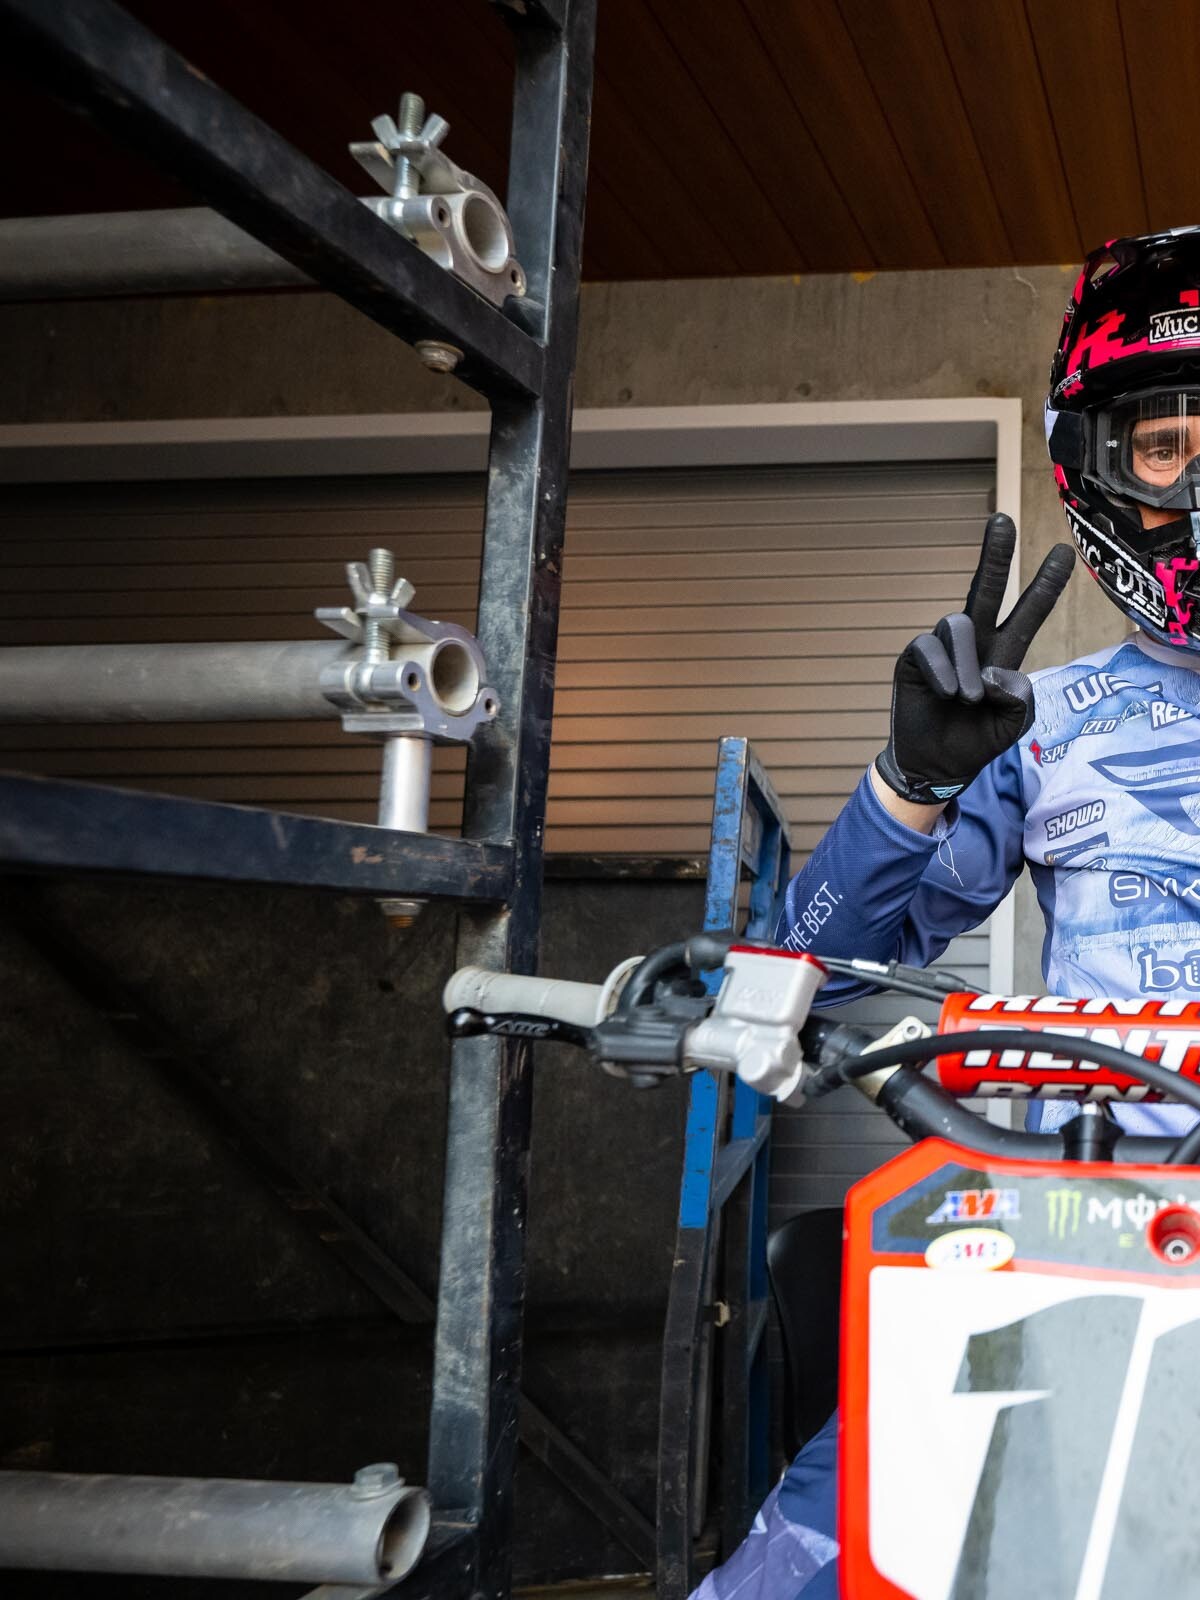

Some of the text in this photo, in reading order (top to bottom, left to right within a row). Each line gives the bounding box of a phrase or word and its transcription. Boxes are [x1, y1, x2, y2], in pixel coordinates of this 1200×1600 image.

[1046, 801, 1104, 840] SHOWA
[802, 881, 843, 935] BEST.
[926, 1189, 1021, 1223] AMA
